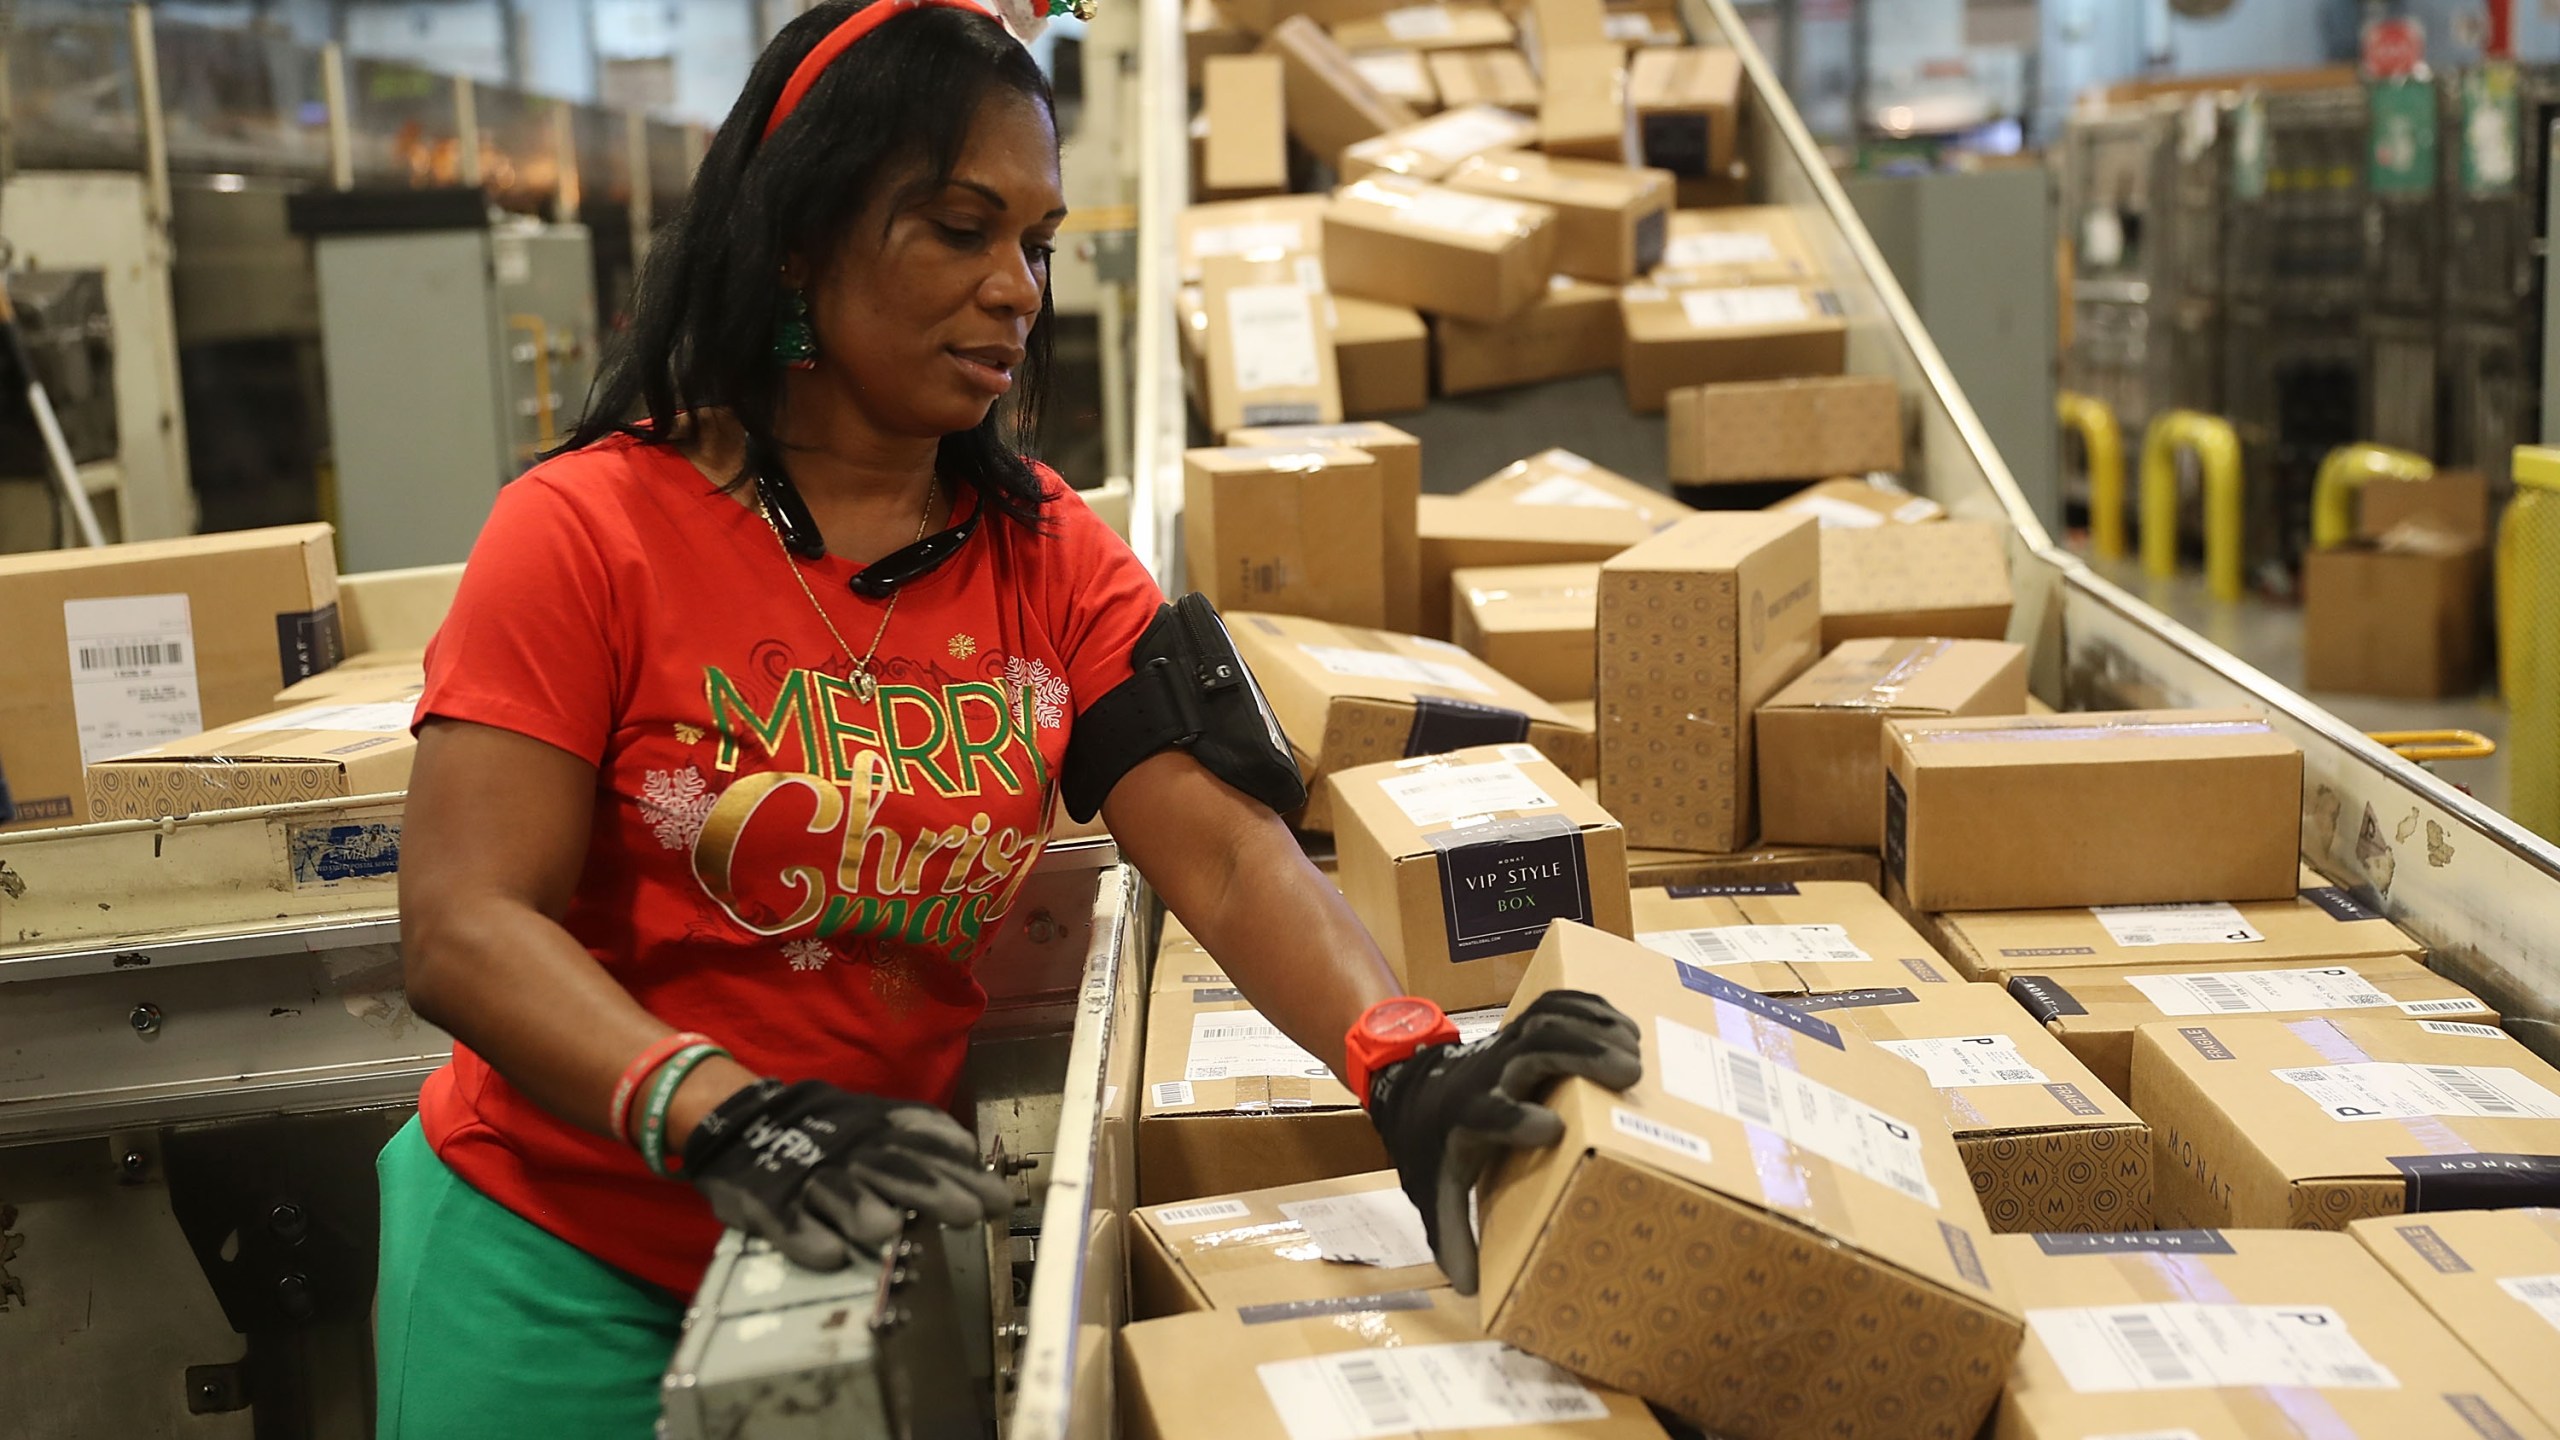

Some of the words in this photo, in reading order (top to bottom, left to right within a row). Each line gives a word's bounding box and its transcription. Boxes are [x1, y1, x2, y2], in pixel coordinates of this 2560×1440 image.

[703, 666, 1047, 798] MERRY
[1498, 856, 1525, 864] MONAT
[1466, 873, 1497, 890] VIP
[1508, 862, 1562, 884] STYLE
[1498, 895, 1536, 912] BOX
[1801, 993, 1877, 1006] MONAT
[2024, 983, 2055, 1005] MONAT
[1723, 986, 1802, 1023] MONAT
[2186, 1029, 2228, 1059] FRAGILE
[2051, 1084, 2096, 1115] FRAGILE
[2336, 1107, 2382, 1116] P
[1868, 1112, 1909, 1140] P
[2045, 1138, 2062, 1153] M
[2121, 1162, 2138, 1177] M
[2167, 1126, 2234, 1211] MONAT
[2440, 1159, 2533, 1170] MONAT
[2021, 1171, 2039, 1186] M
[2047, 1199, 2065, 1213] M
[2277, 1312, 2328, 1326] P
